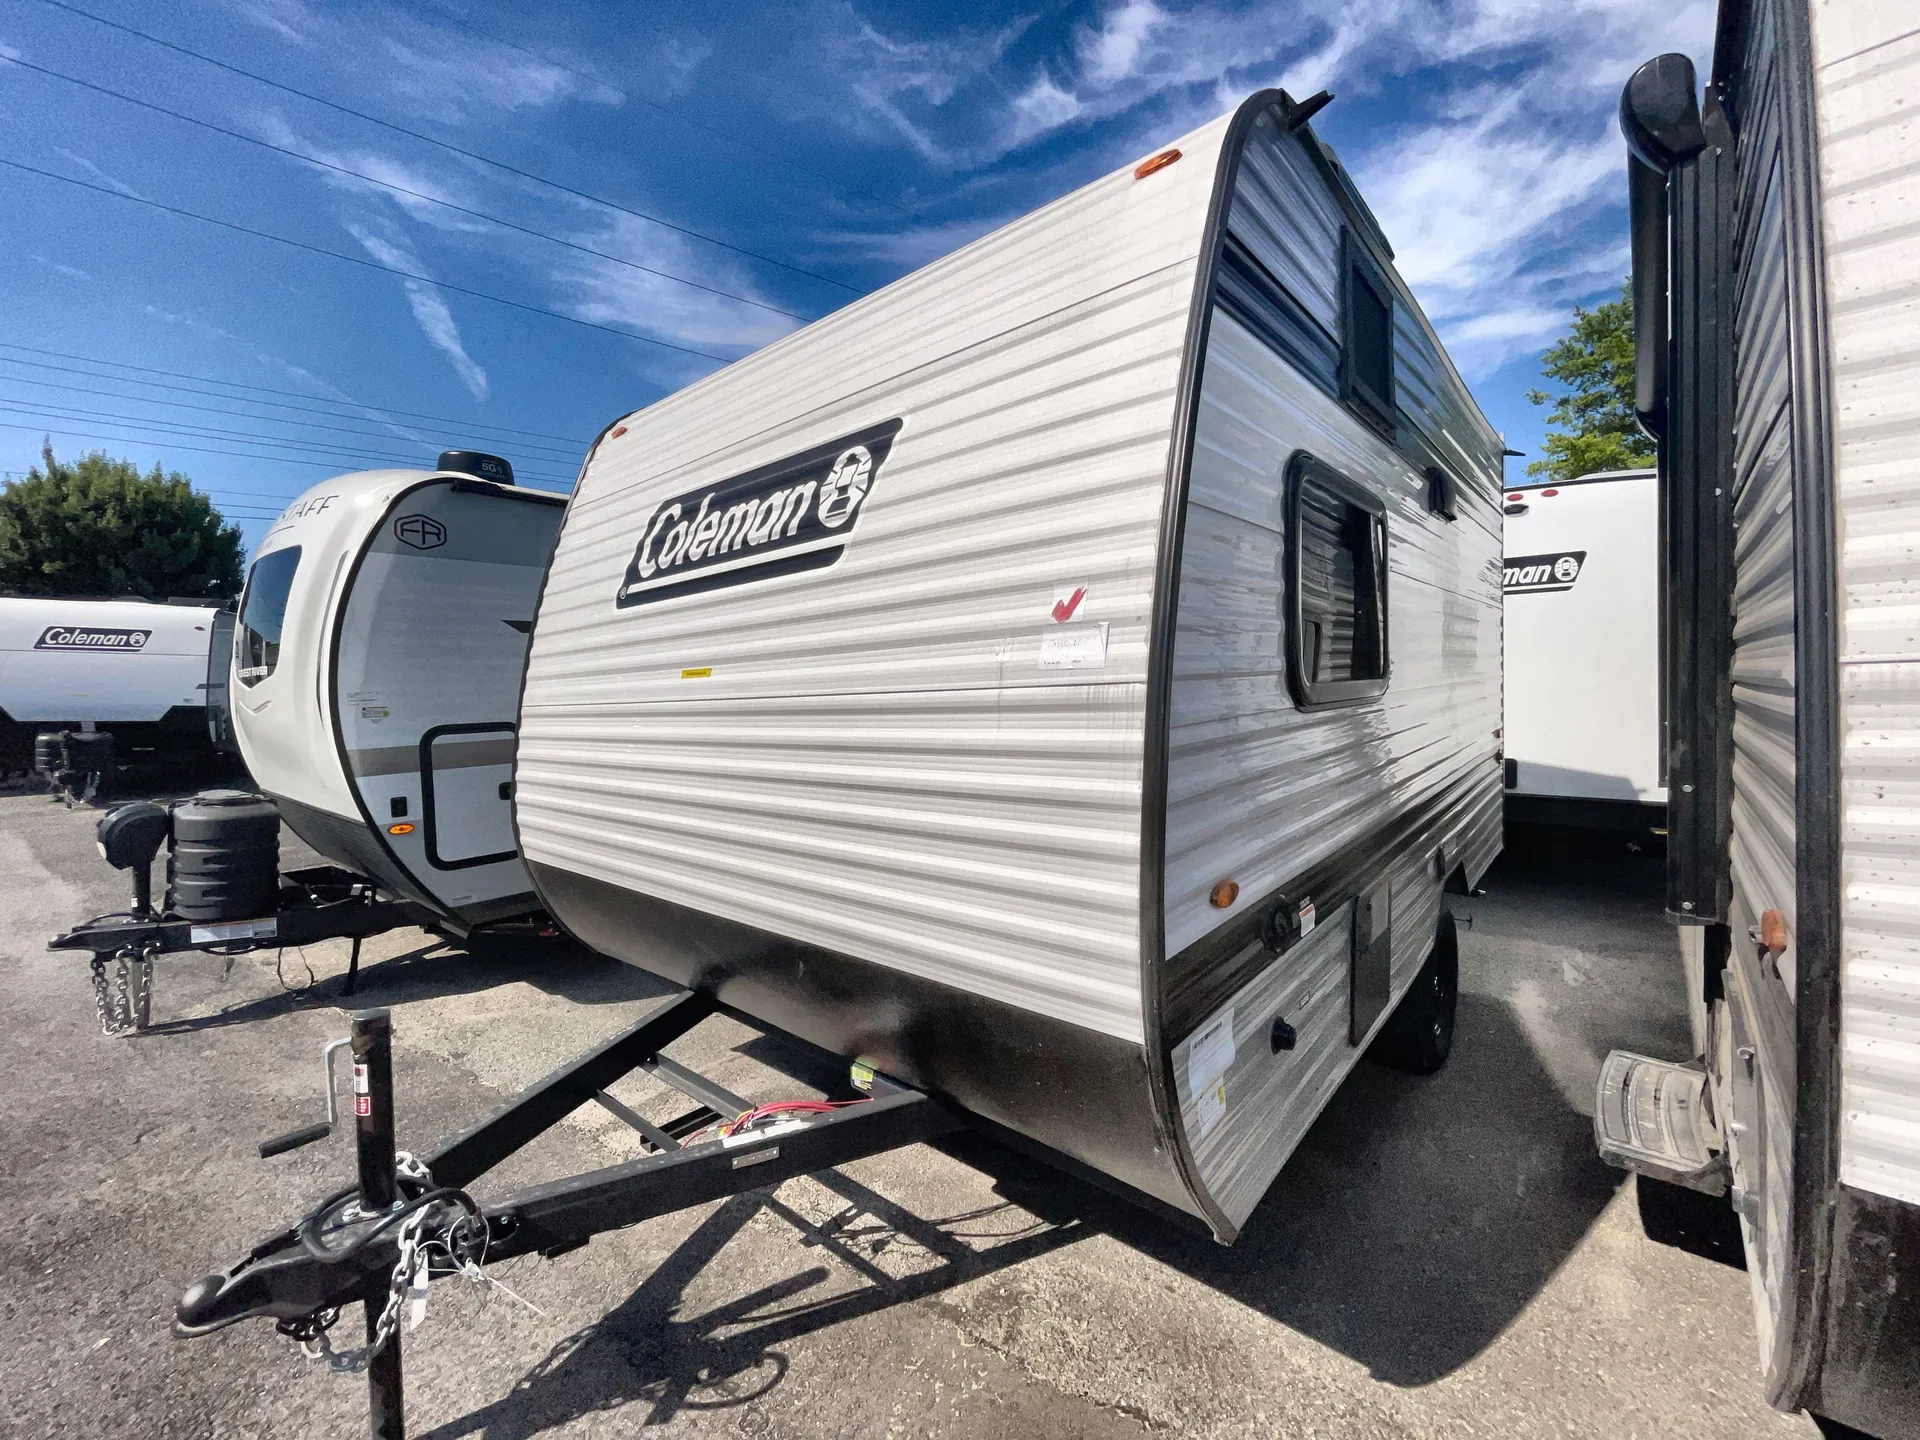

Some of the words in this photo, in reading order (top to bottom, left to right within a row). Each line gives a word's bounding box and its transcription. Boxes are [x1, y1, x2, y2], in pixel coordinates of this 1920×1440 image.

[482, 462, 497, 473] 5G
[638, 481, 817, 578] Coleman
[45, 628, 127, 646] Coleman
